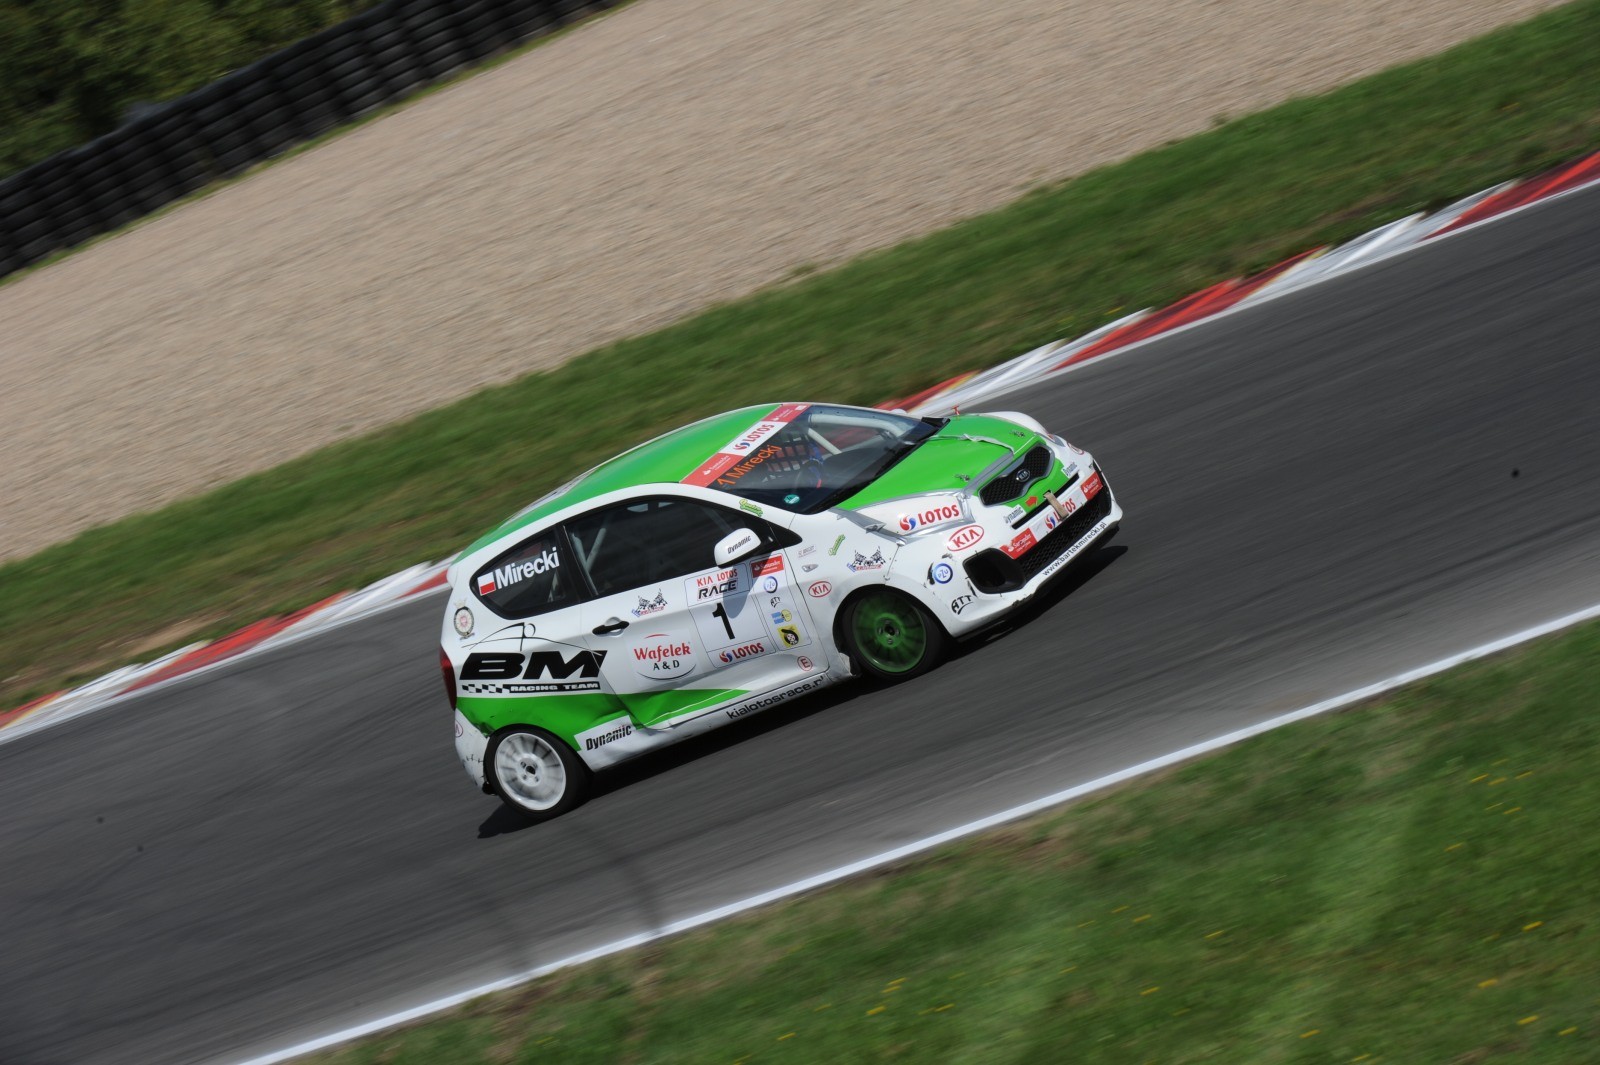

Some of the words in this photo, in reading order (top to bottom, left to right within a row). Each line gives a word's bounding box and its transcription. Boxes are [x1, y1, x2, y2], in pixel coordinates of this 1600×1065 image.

[746, 424, 774, 442] LOTOS
[727, 444, 782, 479] Mirecki
[917, 504, 960, 526] LOTOS
[1054, 498, 1076, 519] LOS
[727, 535, 752, 555] Dynamic
[952, 529, 980, 548] KIA
[495, 546, 560, 590] Mirecki
[697, 576, 714, 587] KIA
[716, 569, 738, 581] LOTOS
[698, 580, 737, 599] RACE
[811, 584, 829, 595] KIA
[712, 602, 735, 640] 1
[633, 642, 692, 662] Wafelek
[732, 642, 765, 659] LOTOS
[459, 650, 608, 680] BM
[653, 662, 660, 671] A
[662, 661, 671, 670] &
[673, 659, 680, 668] D
[585, 724, 632, 751] Dynamic
